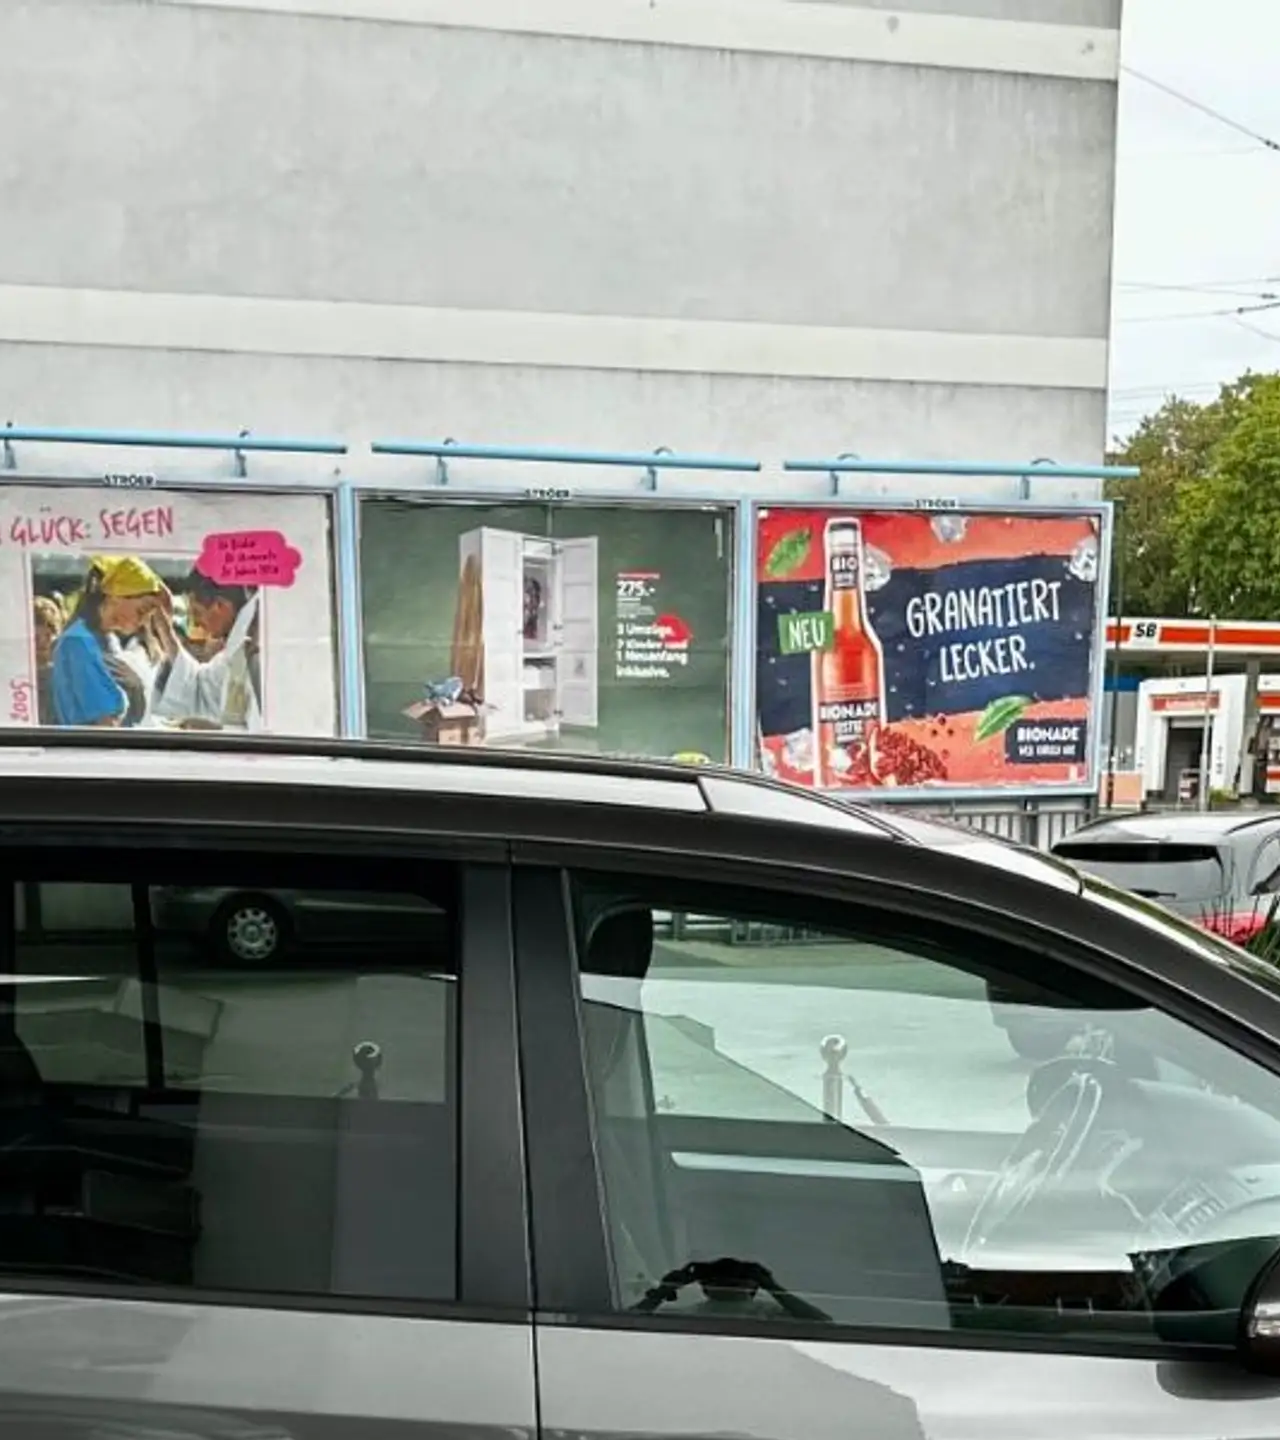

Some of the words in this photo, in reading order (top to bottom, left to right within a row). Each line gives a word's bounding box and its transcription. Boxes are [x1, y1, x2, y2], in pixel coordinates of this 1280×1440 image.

[11, 506, 91, 546] GLÜCK:
[99, 507, 173, 539] SEGEN
[906, 578, 1061, 637] GRANATIERT
[789, 617, 825, 649] NEU
[1135, 622, 1157, 638] SB
[940, 634, 1036, 682] LECKER.
[1017, 727, 1080, 741] BIONADE
